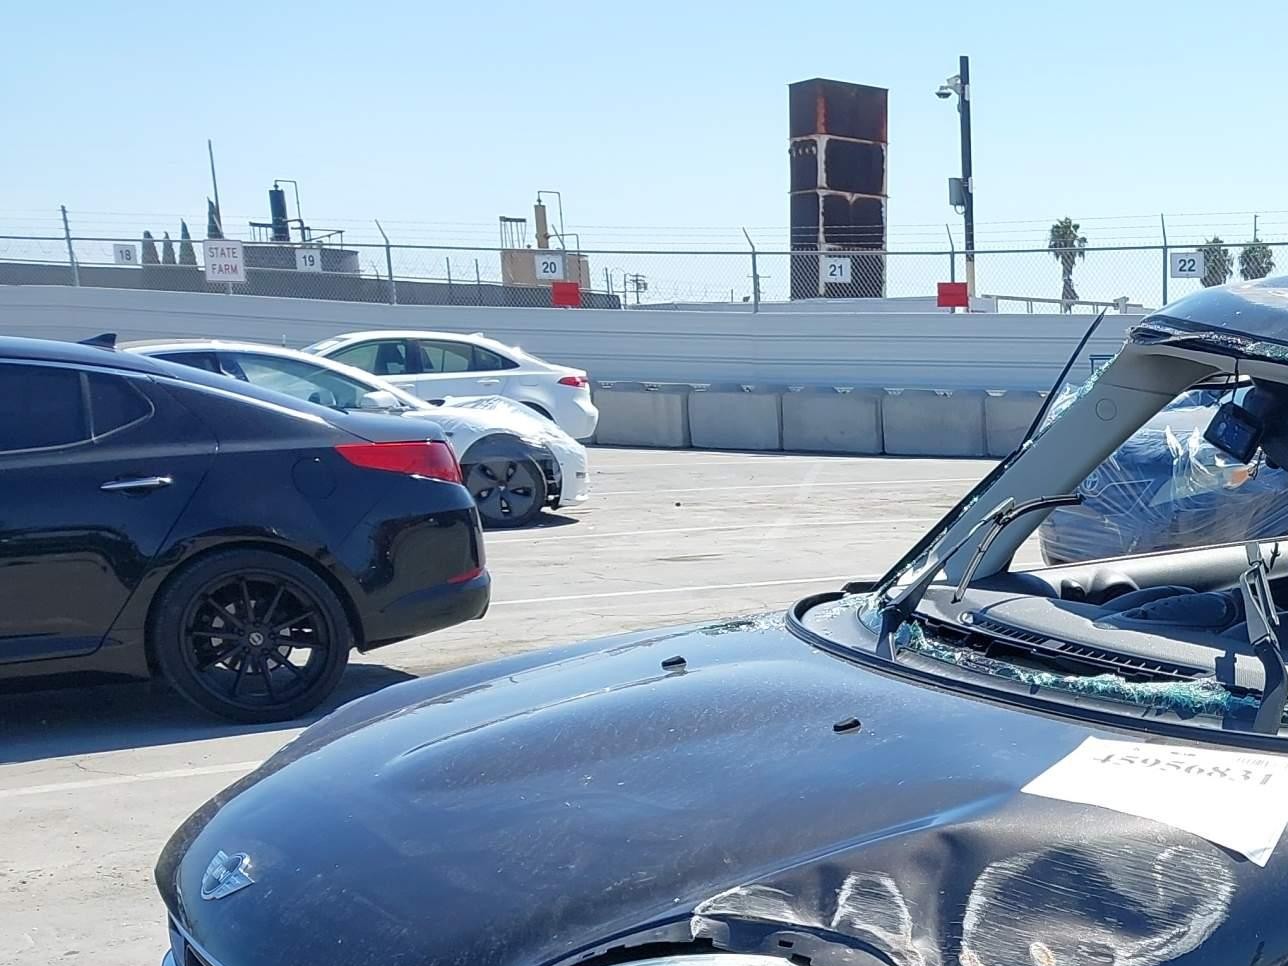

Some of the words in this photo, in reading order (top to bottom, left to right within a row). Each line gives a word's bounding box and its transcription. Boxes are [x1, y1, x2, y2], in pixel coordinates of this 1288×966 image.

[119, 249, 132, 261] 18
[208, 246, 239, 259] STATE
[302, 254, 315, 267] 19
[541, 260, 557, 274] 20
[1178, 258, 1196, 272] 22
[211, 263, 239, 276] FARM
[828, 263, 844, 277] 21
